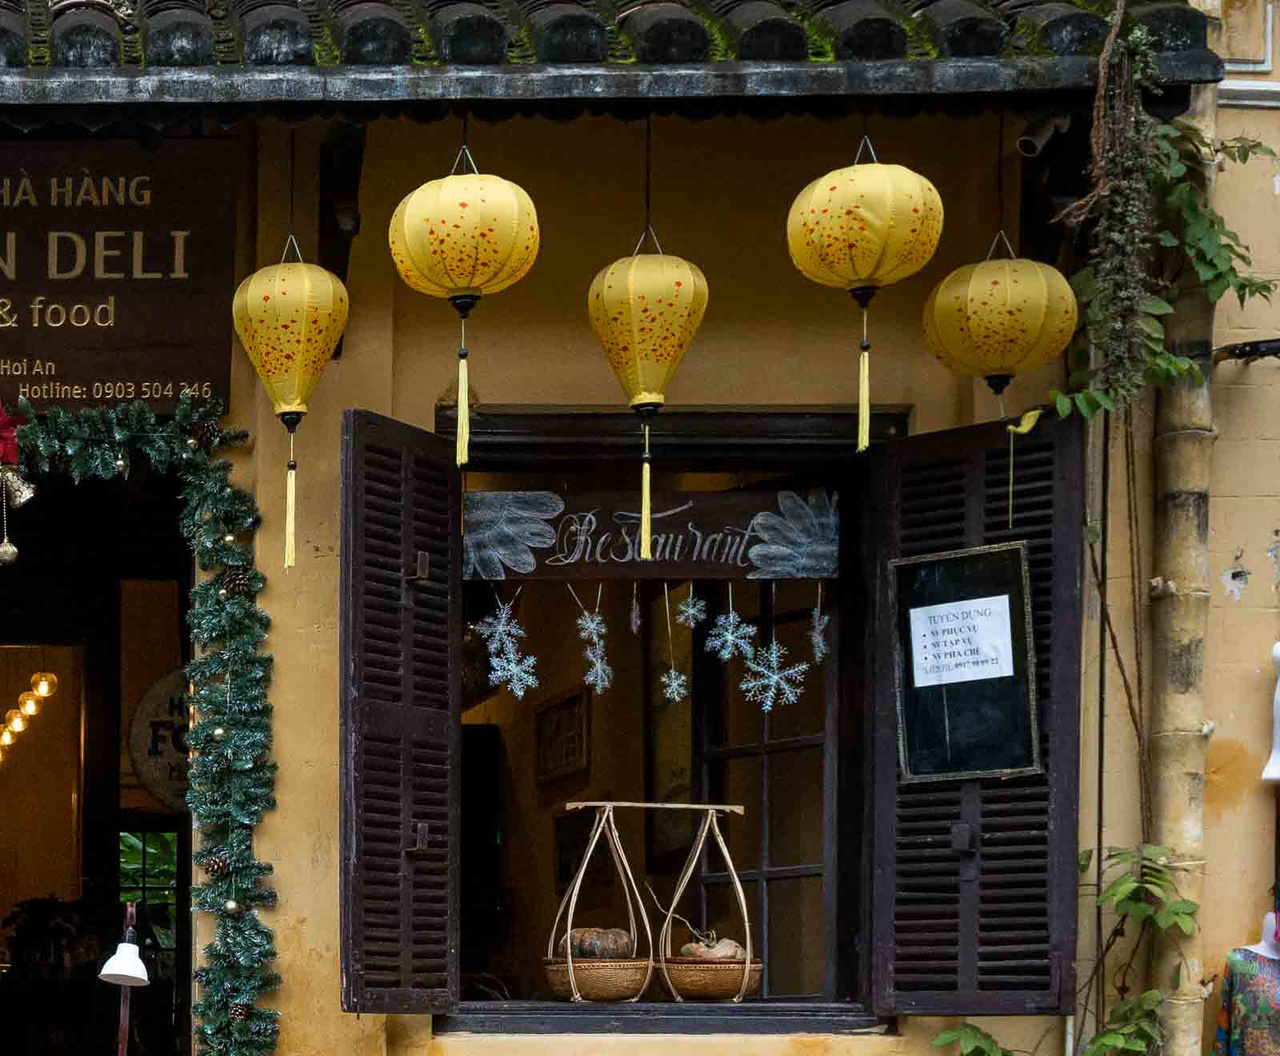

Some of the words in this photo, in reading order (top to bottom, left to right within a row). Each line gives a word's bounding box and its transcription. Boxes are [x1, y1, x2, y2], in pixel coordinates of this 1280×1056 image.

[51, 167, 151, 206] HÀNG
[47, 230, 191, 280] DELI
[31, 295, 115, 328] food
[32, 359, 56, 375] An
[19, 382, 87, 399] Hotline:
[92, 382, 136, 398] 0903
[141, 382, 174, 398] 504
